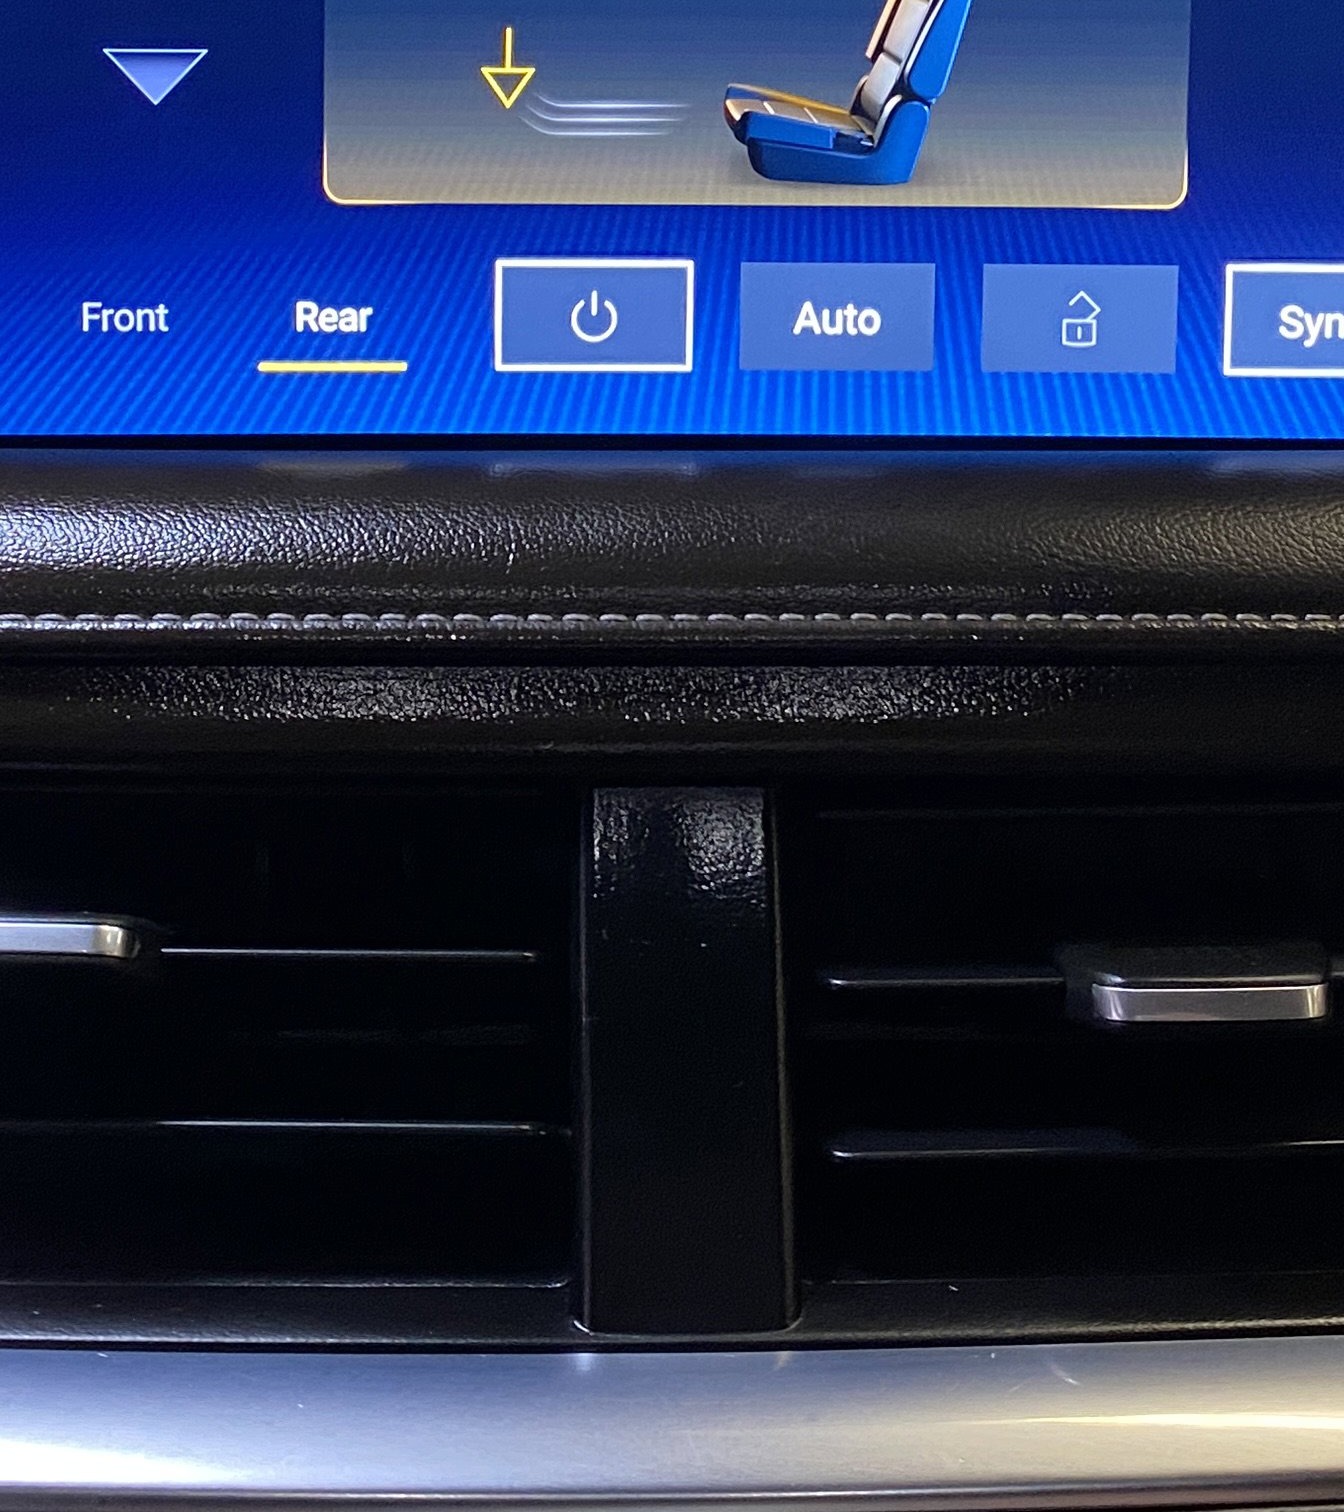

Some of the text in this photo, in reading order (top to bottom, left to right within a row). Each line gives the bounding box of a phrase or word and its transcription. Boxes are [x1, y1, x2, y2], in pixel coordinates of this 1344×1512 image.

[82, 301, 169, 333] Front
[295, 300, 374, 333] Rear
[792, 300, 882, 336] Auto
